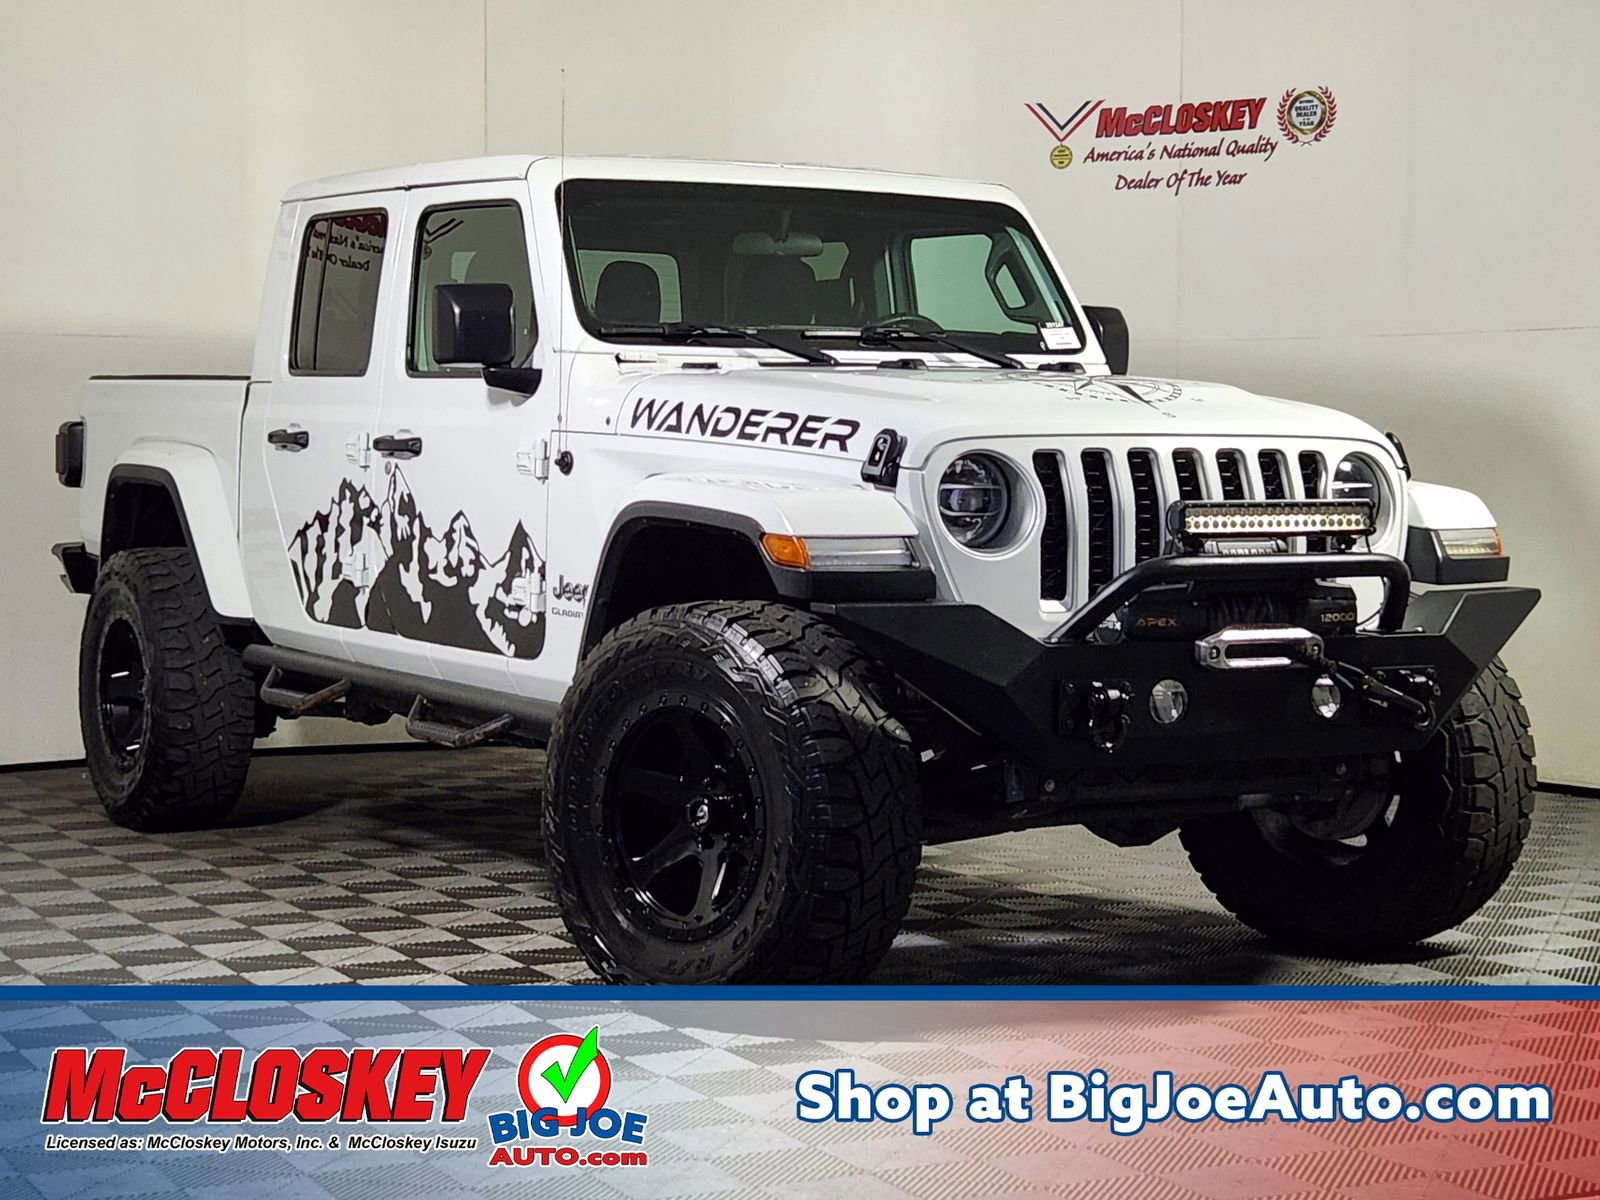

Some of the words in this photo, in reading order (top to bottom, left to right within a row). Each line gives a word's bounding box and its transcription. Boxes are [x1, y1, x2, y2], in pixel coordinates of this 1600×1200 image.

[1095, 97, 1267, 138] McCLOSKEY
[1083, 141, 1156, 163] America's
[1160, 137, 1225, 160] National
[1226, 135, 1279, 162] Quality
[1115, 170, 1163, 191] Dealer
[1166, 168, 1188, 196] Of
[1187, 167, 1212, 188] The
[1216, 169, 1248, 187] Year
[630, 397, 861, 453] WANDERER
[1135, 617, 1178, 627] APEX
[1320, 611, 1356, 623] 12000
